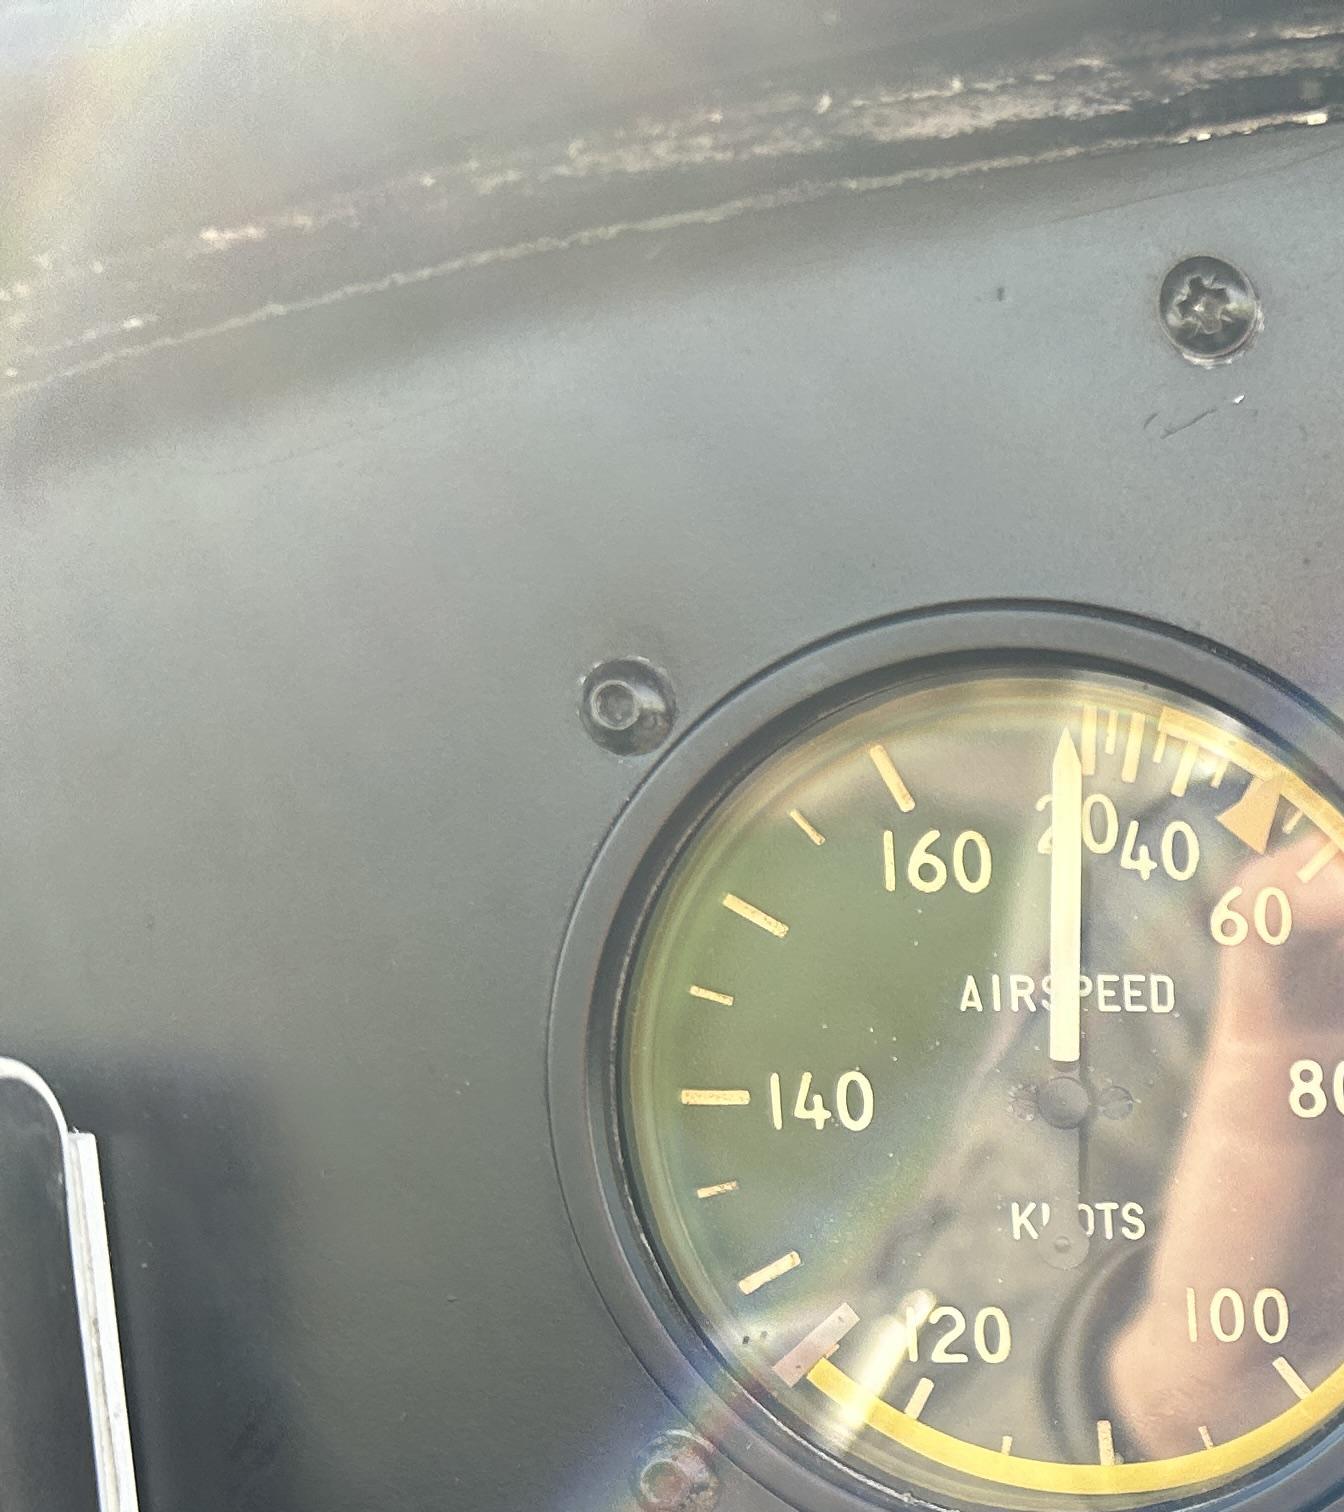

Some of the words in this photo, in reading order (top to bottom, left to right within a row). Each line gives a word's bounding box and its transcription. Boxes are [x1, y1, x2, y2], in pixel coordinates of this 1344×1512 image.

[881, 829, 993, 894] 160
[1121, 821, 1200, 881] 40
[1210, 889, 1292, 947] 60
[767, 1071, 875, 1132] 140
[1011, 1202, 1146, 1240] KOTS
[906, 1306, 1011, 1364] 120
[1184, 1287, 1289, 1343] 100
